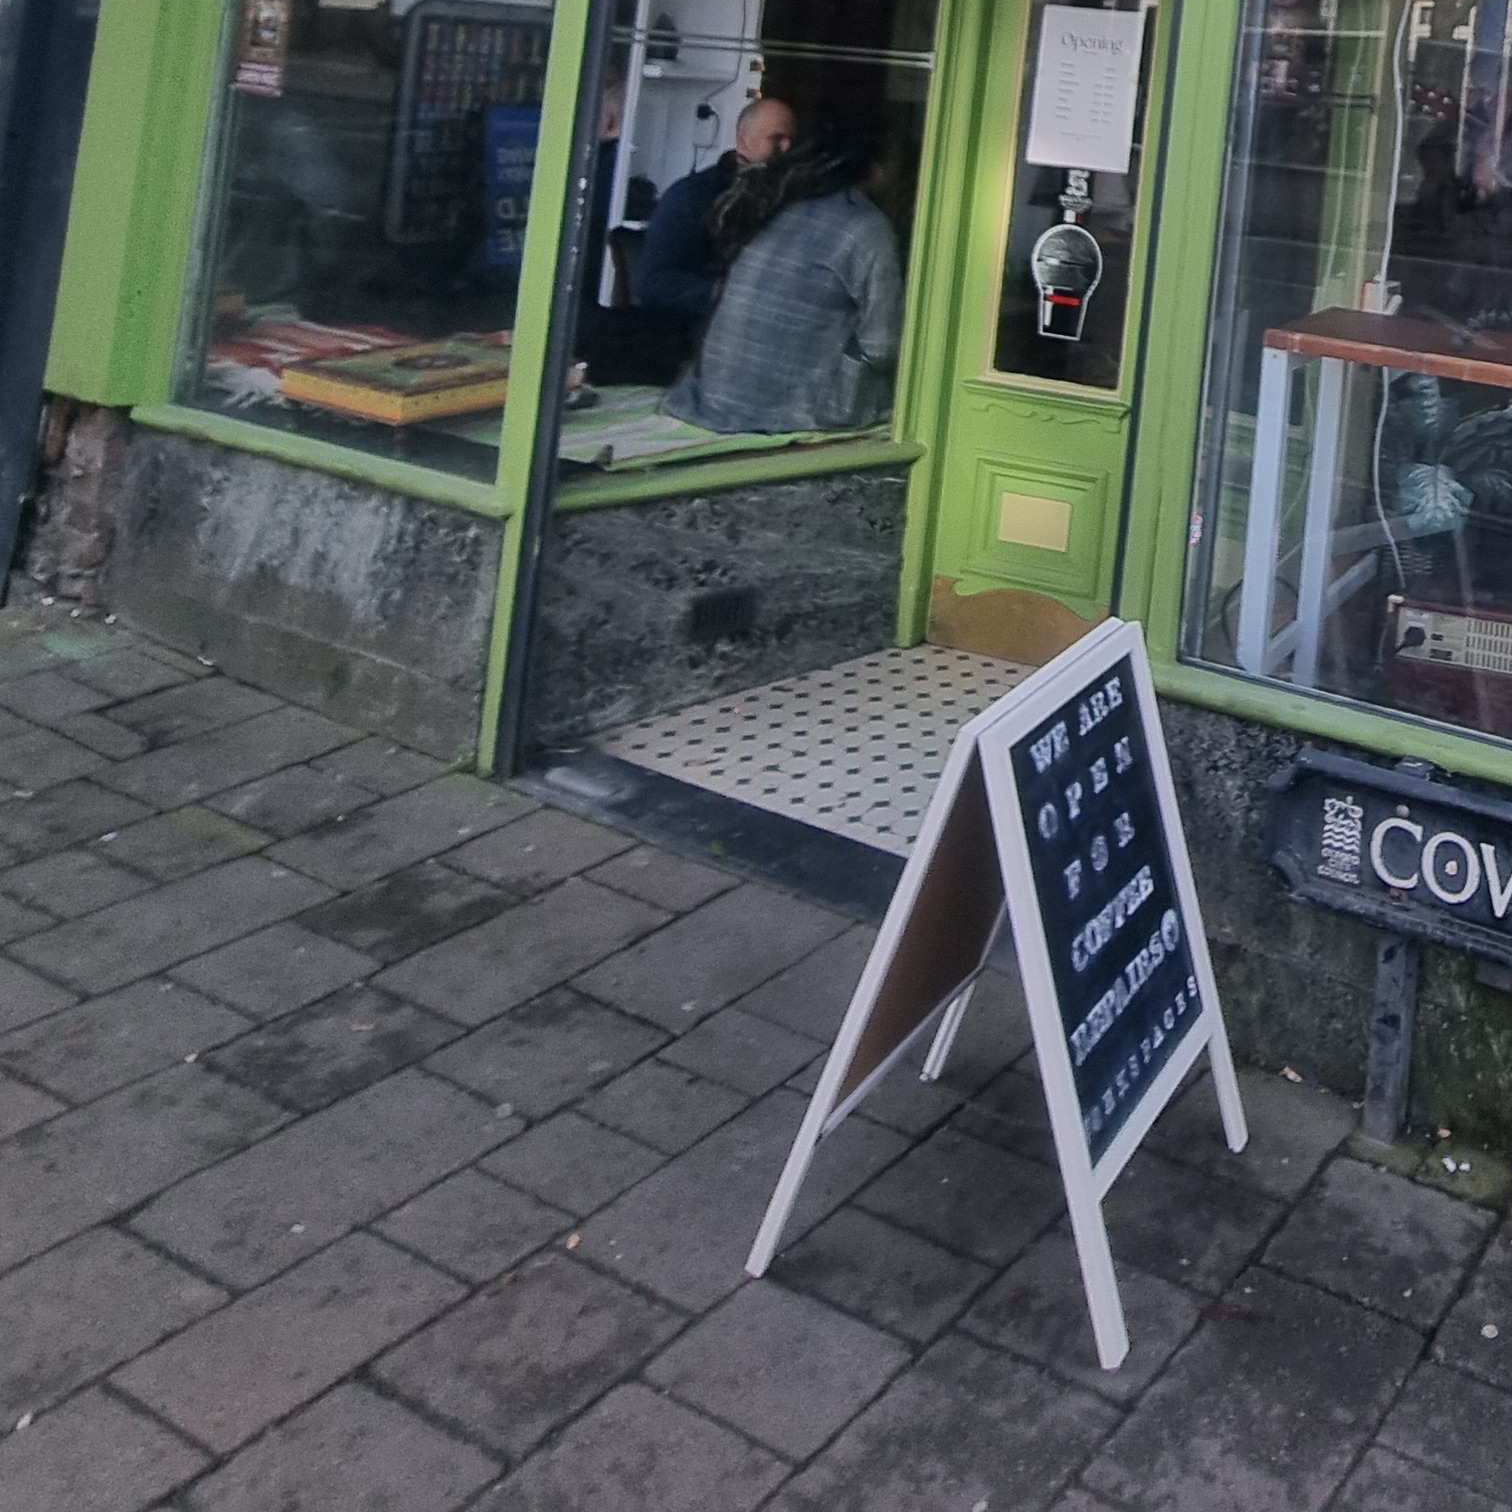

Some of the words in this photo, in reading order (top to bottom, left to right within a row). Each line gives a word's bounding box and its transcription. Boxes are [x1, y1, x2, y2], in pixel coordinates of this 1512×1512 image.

[1060, 32, 1124, 55] Opening
[1029, 720, 1070, 774] WE
[1079, 676, 1124, 737] ARE
[1038, 736, 1133, 839] OPEN
[1063, 812, 1135, 900] FOR
[1071, 864, 1155, 972] COFFEE
